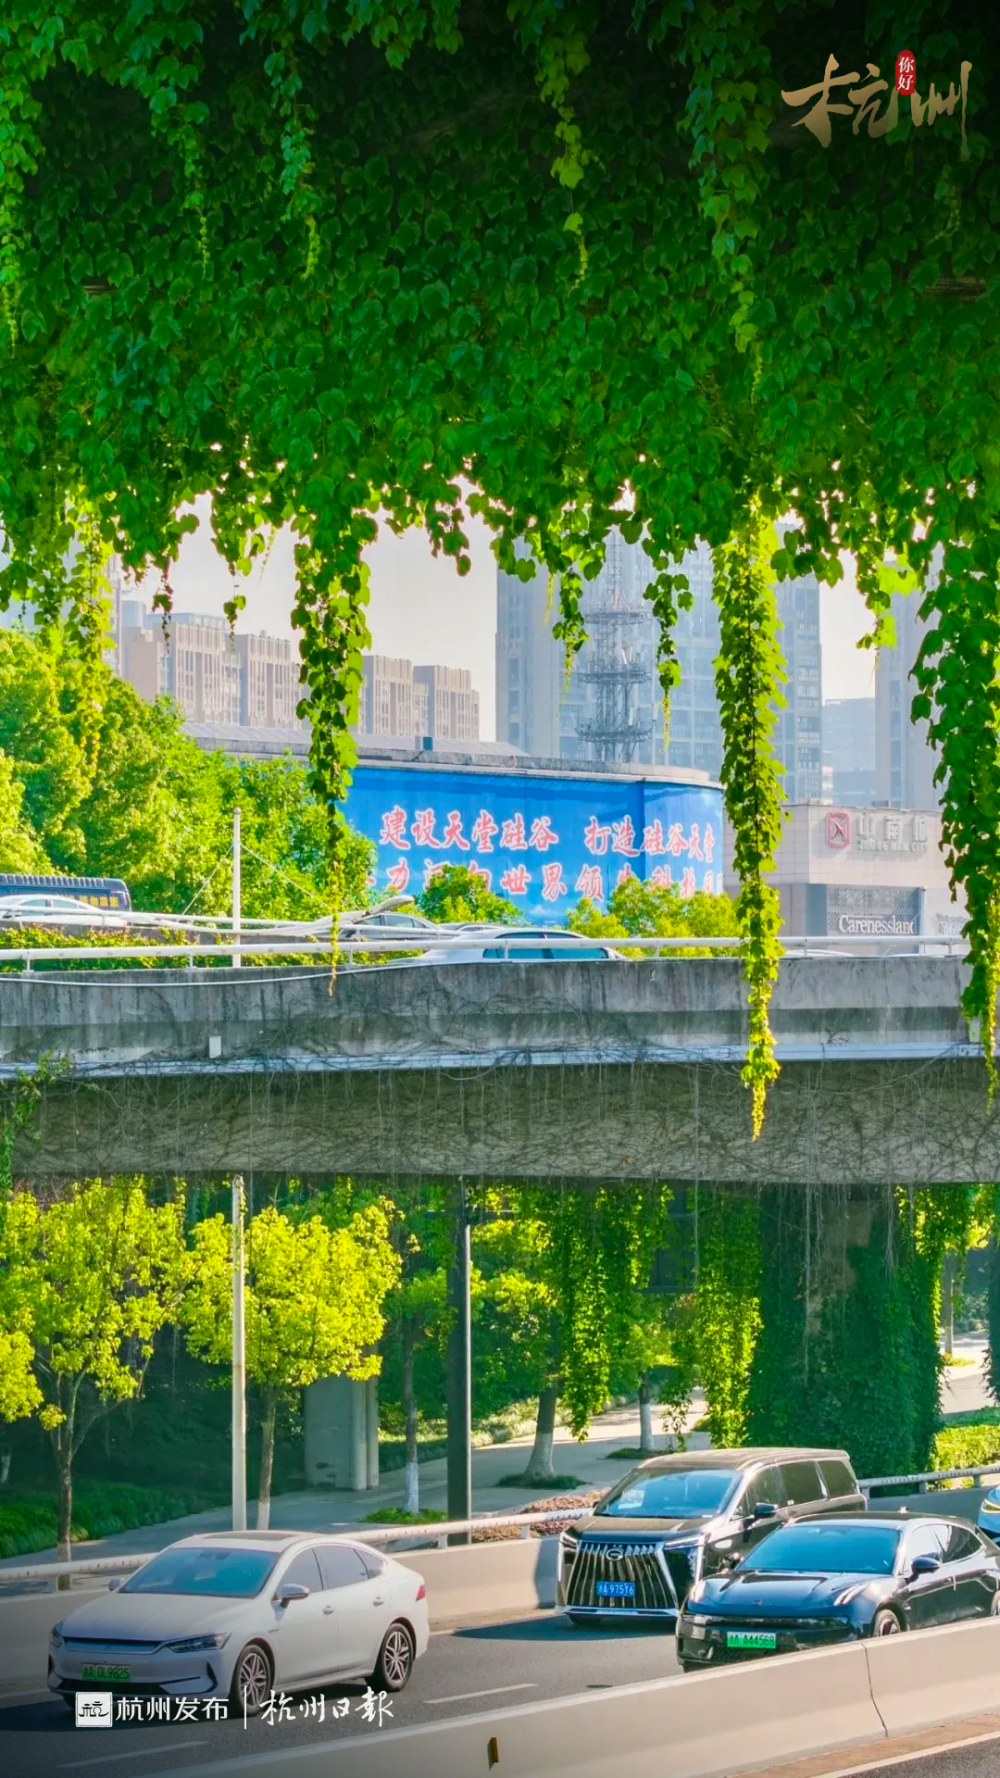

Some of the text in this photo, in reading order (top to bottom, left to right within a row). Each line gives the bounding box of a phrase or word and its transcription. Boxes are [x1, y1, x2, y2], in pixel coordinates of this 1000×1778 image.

[379, 804, 560, 854] 建设天堂硅谷
[838, 914, 918, 934] Carenessland
